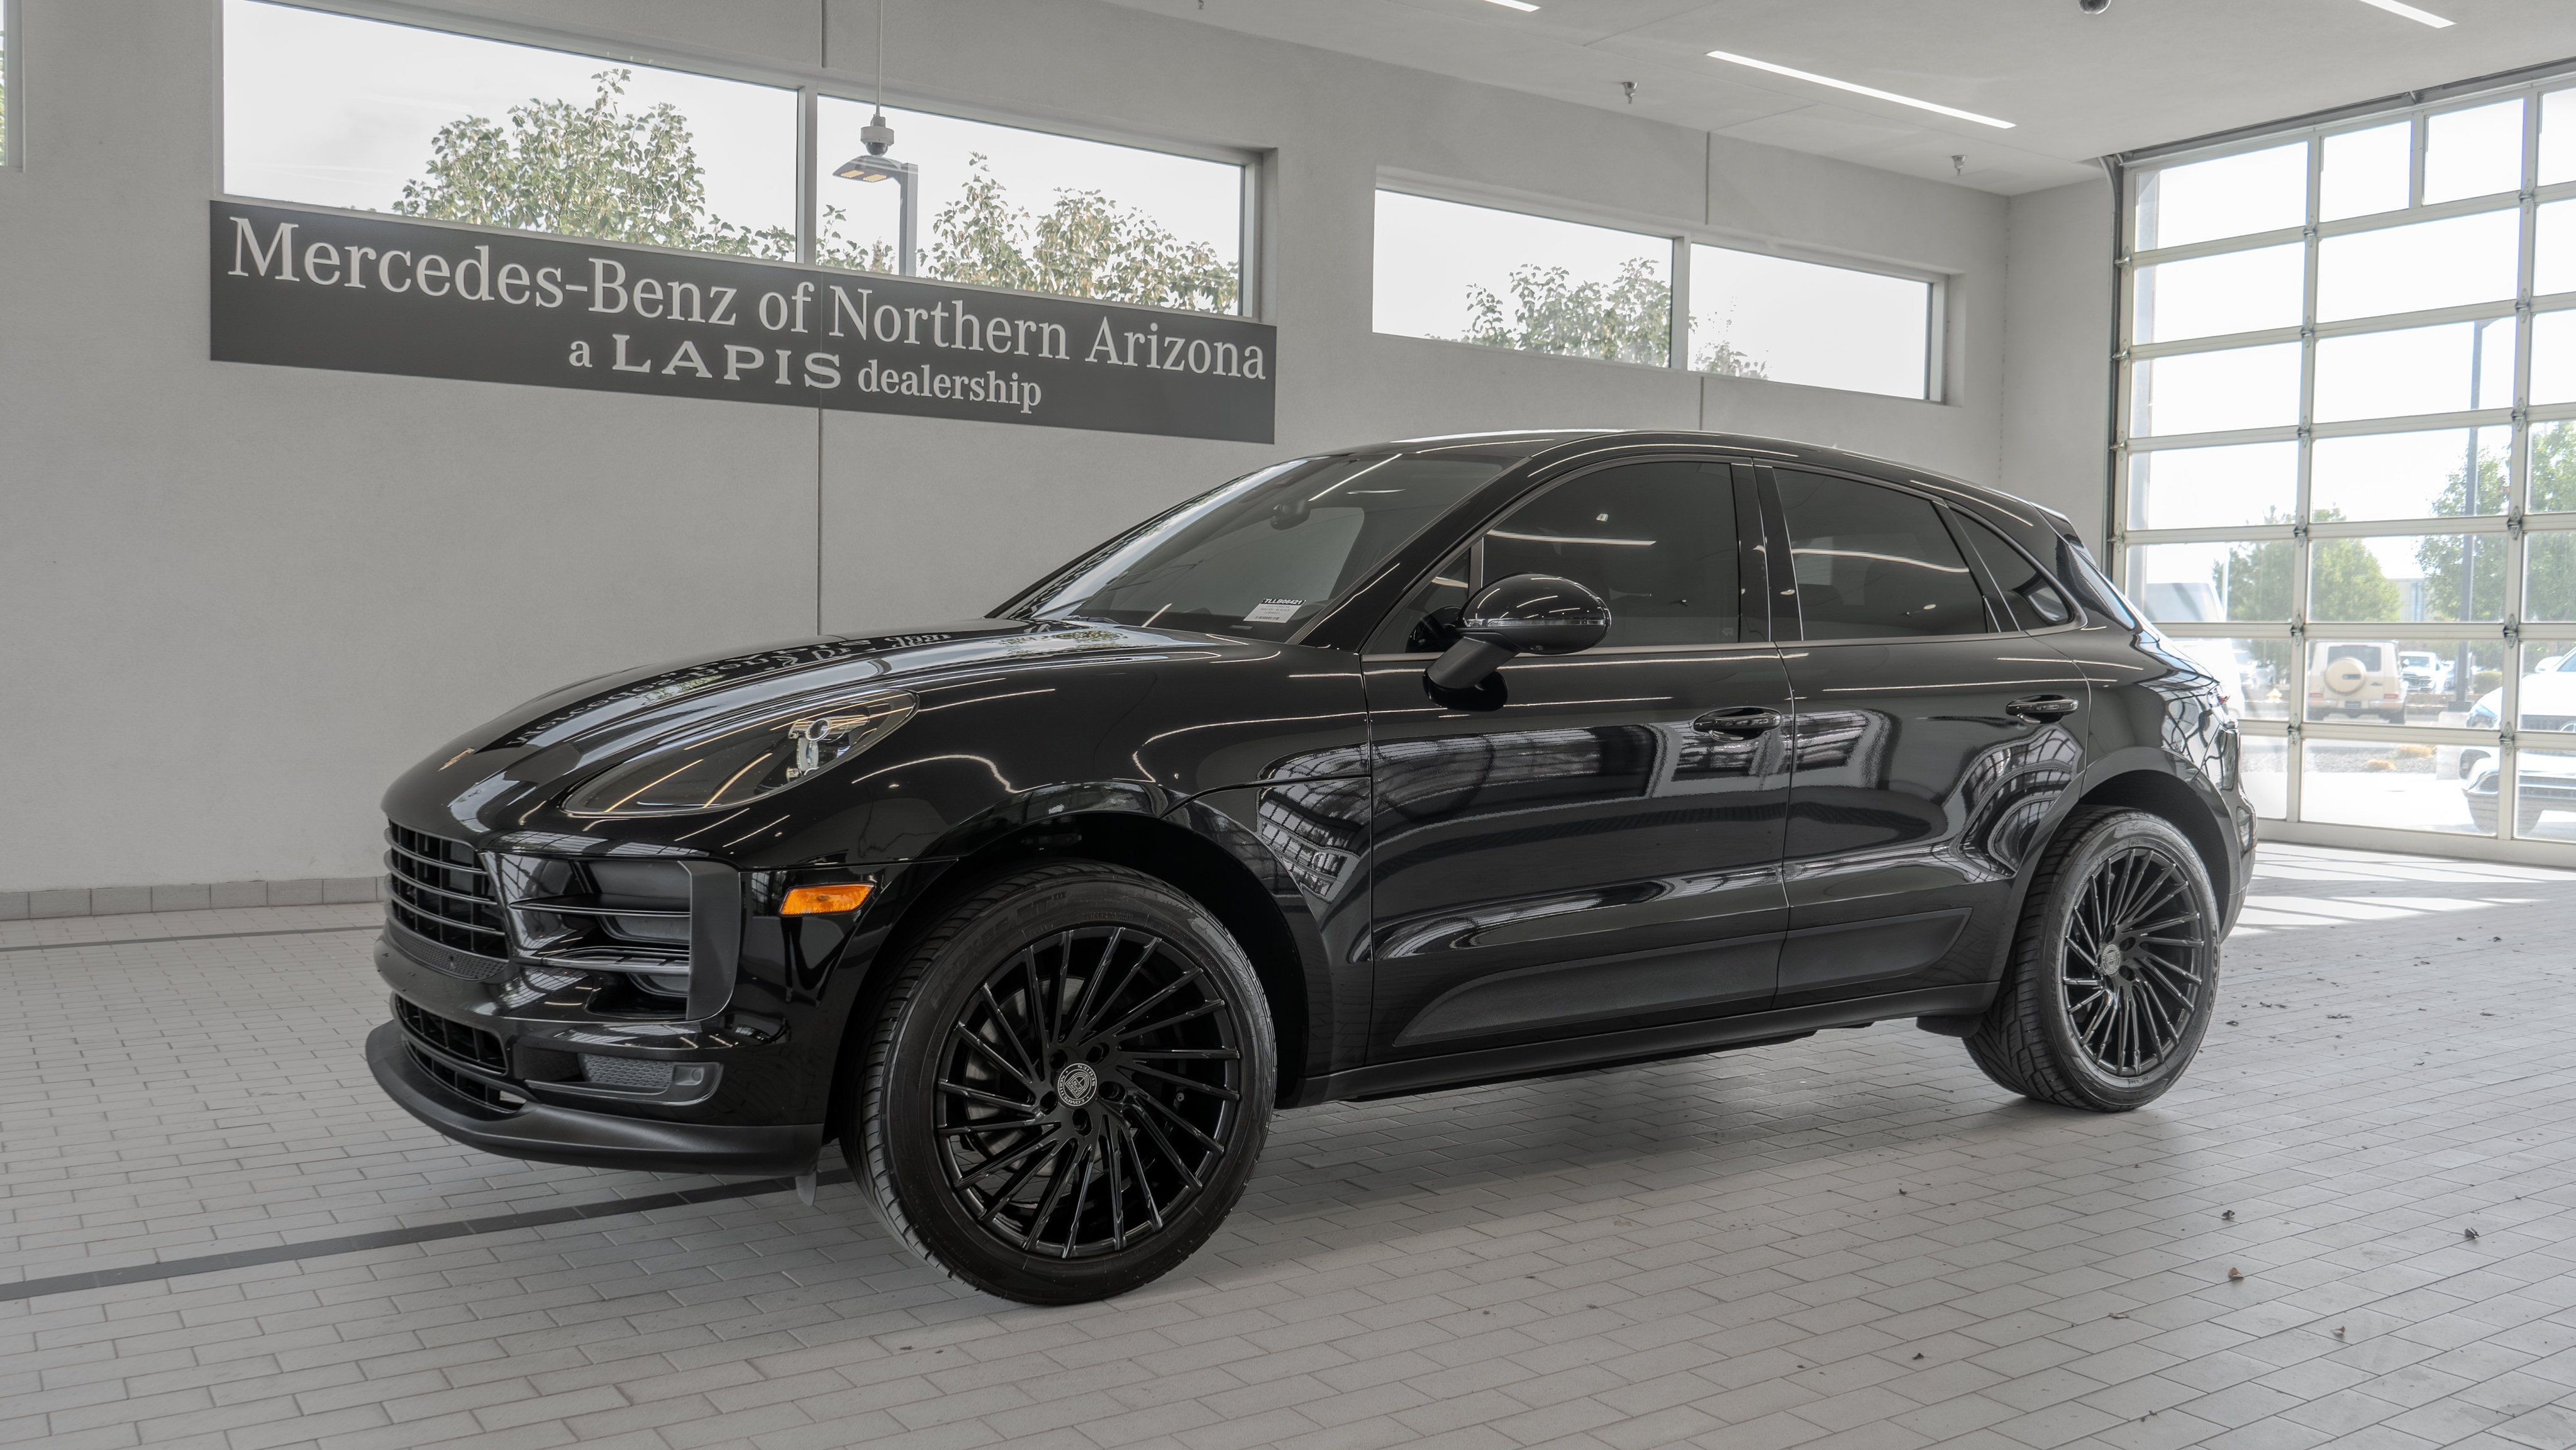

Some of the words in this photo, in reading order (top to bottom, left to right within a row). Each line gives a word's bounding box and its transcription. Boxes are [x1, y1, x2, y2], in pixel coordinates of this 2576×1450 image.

[228, 216, 738, 326] Mercedes-Benz
[758, 281, 815, 333] of
[828, 284, 1070, 360] Northern
[1084, 316, 1266, 380] Arizona
[569, 340, 593, 368] a
[612, 333, 841, 389] LAPIS
[858, 359, 1041, 414] dealership
[2207, 925, 2218, 1012] TOYO
